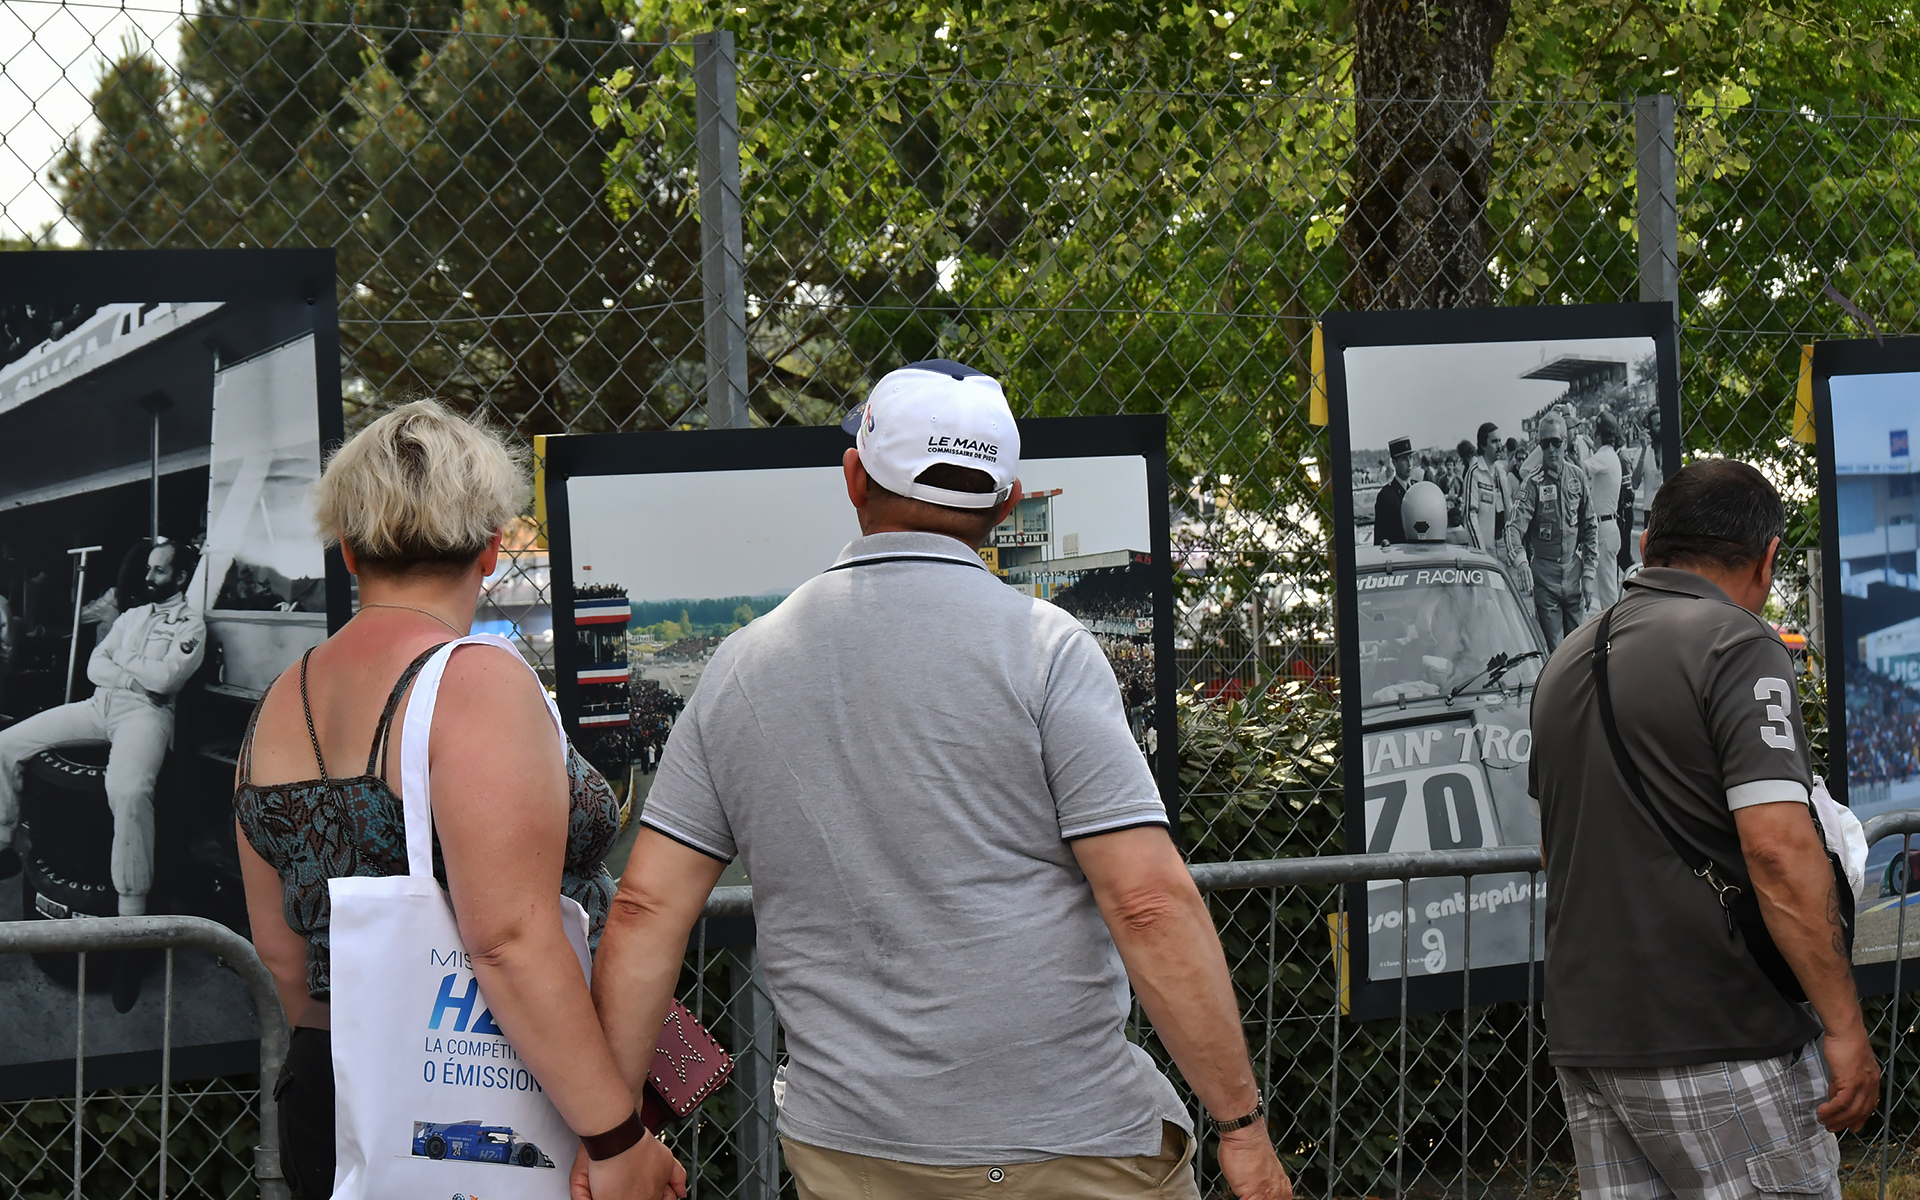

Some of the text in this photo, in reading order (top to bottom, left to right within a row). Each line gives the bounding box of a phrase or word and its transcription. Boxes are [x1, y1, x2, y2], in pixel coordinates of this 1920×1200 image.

[927, 447, 997, 463] COMMISSAIRE DE PISTE
[928, 436, 998, 455] LE MANS
[999, 533, 1045, 543] MARTINI
[979, 551, 993, 561] CH
[1357, 569, 1484, 591] rbour RACING
[1753, 677, 1796, 751] 3
[1364, 772, 1484, 853] 70
[1368, 907, 1417, 934] son
[431, 949, 473, 971] MIS
[425, 1037, 442, 1053] LA
[443, 1057, 542, 1093] ÉMISSION
